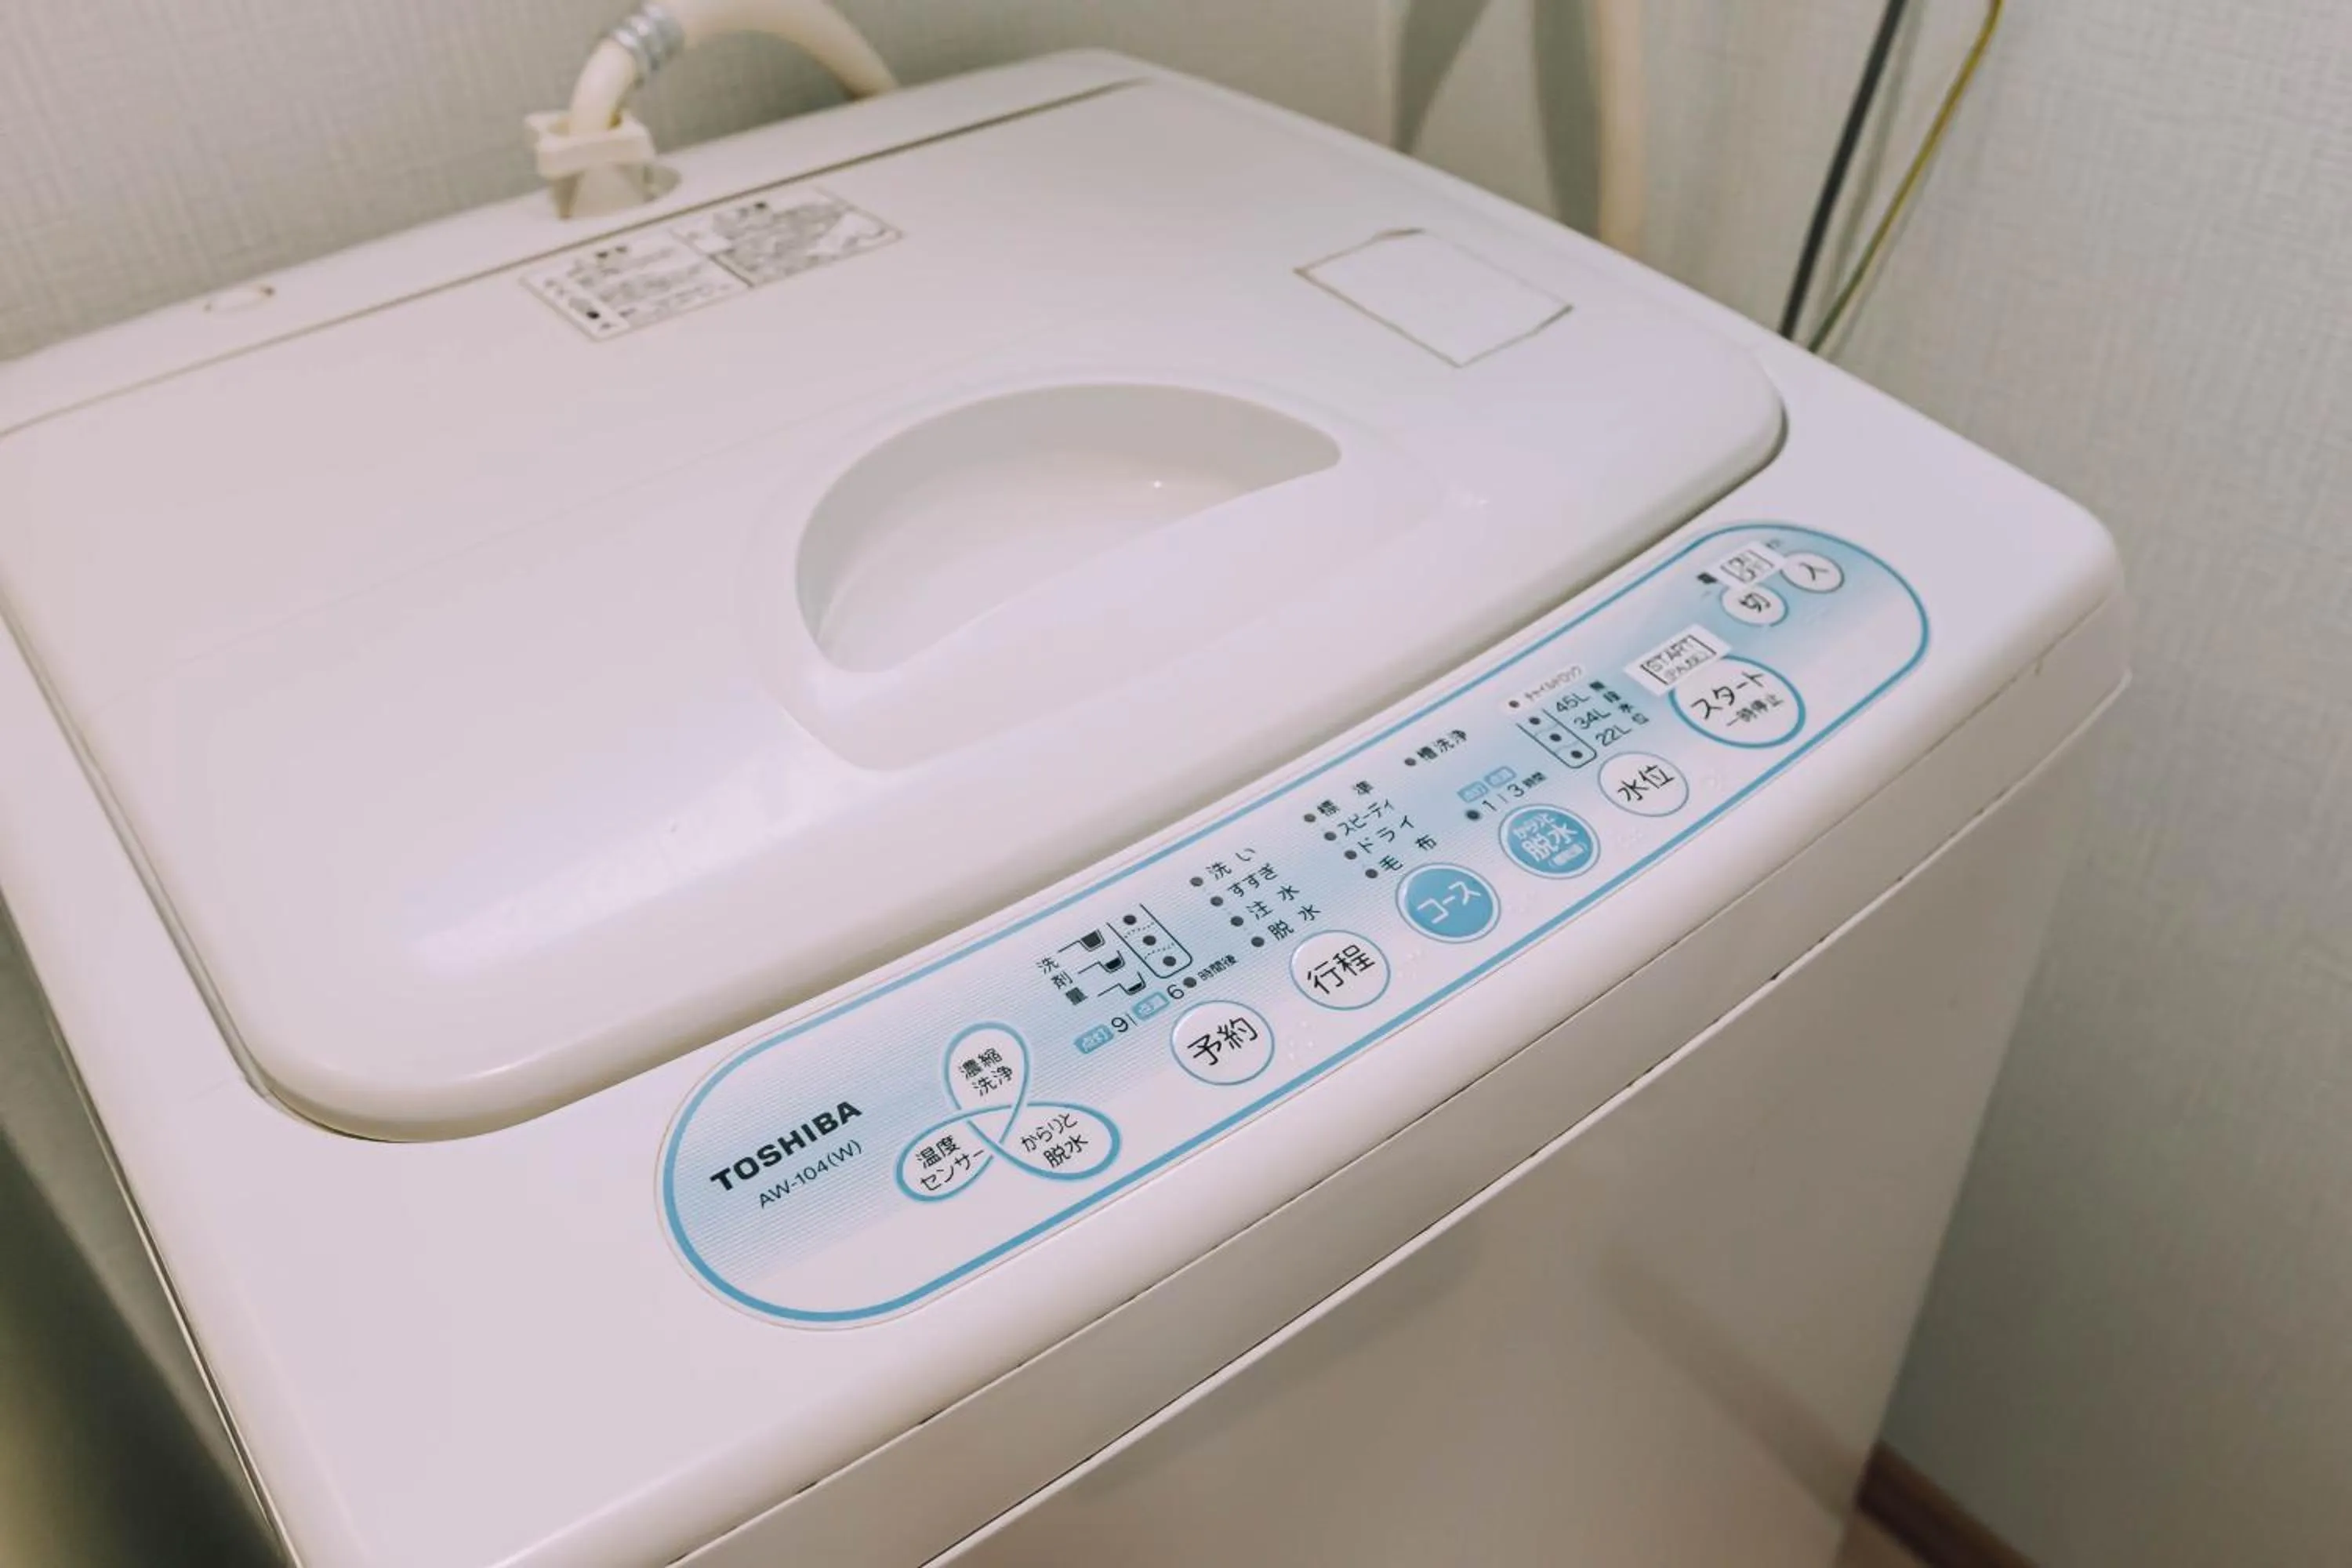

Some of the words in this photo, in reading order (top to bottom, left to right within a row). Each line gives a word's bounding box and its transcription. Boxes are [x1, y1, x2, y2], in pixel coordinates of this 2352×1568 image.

[1799, 562, 1829, 581] 入
[1740, 592, 1770, 612] 切
[1555, 692, 1591, 713] 45L
[1691, 671, 1764, 720] スタート
[1574, 708, 1612, 730] 34L
[1595, 725, 1632, 746] 22L
[1507, 783, 1525, 797] 3
[1617, 764, 1675, 802] 水位
[1358, 815, 1414, 855] ドライ
[1206, 848, 1256, 880] 洗い
[1380, 834, 1438, 873] 毛布
[1228, 863, 1279, 897] すすぎ
[1247, 884, 1300, 920] 注水
[1417, 880, 1481, 924] コース
[1269, 903, 1322, 942] 脱水
[1308, 944, 1376, 994] 行程
[1167, 984, 1185, 1000] 6
[1110, 1016, 1130, 1033] 9
[1188, 1017, 1258, 1066] 予約
[959, 1047, 1002, 1080] 濃縮
[972, 1065, 1013, 1096] 洗浄
[710, 1101, 862, 1191] TOSHIBA
[1022, 1113, 1078, 1152] からりと
[916, 1134, 961, 1170] 温度
[1044, 1134, 1089, 1168] 脱水
[758, 1138, 863, 1209] AW-104(W)
[920, 1149, 985, 1191] センサー
